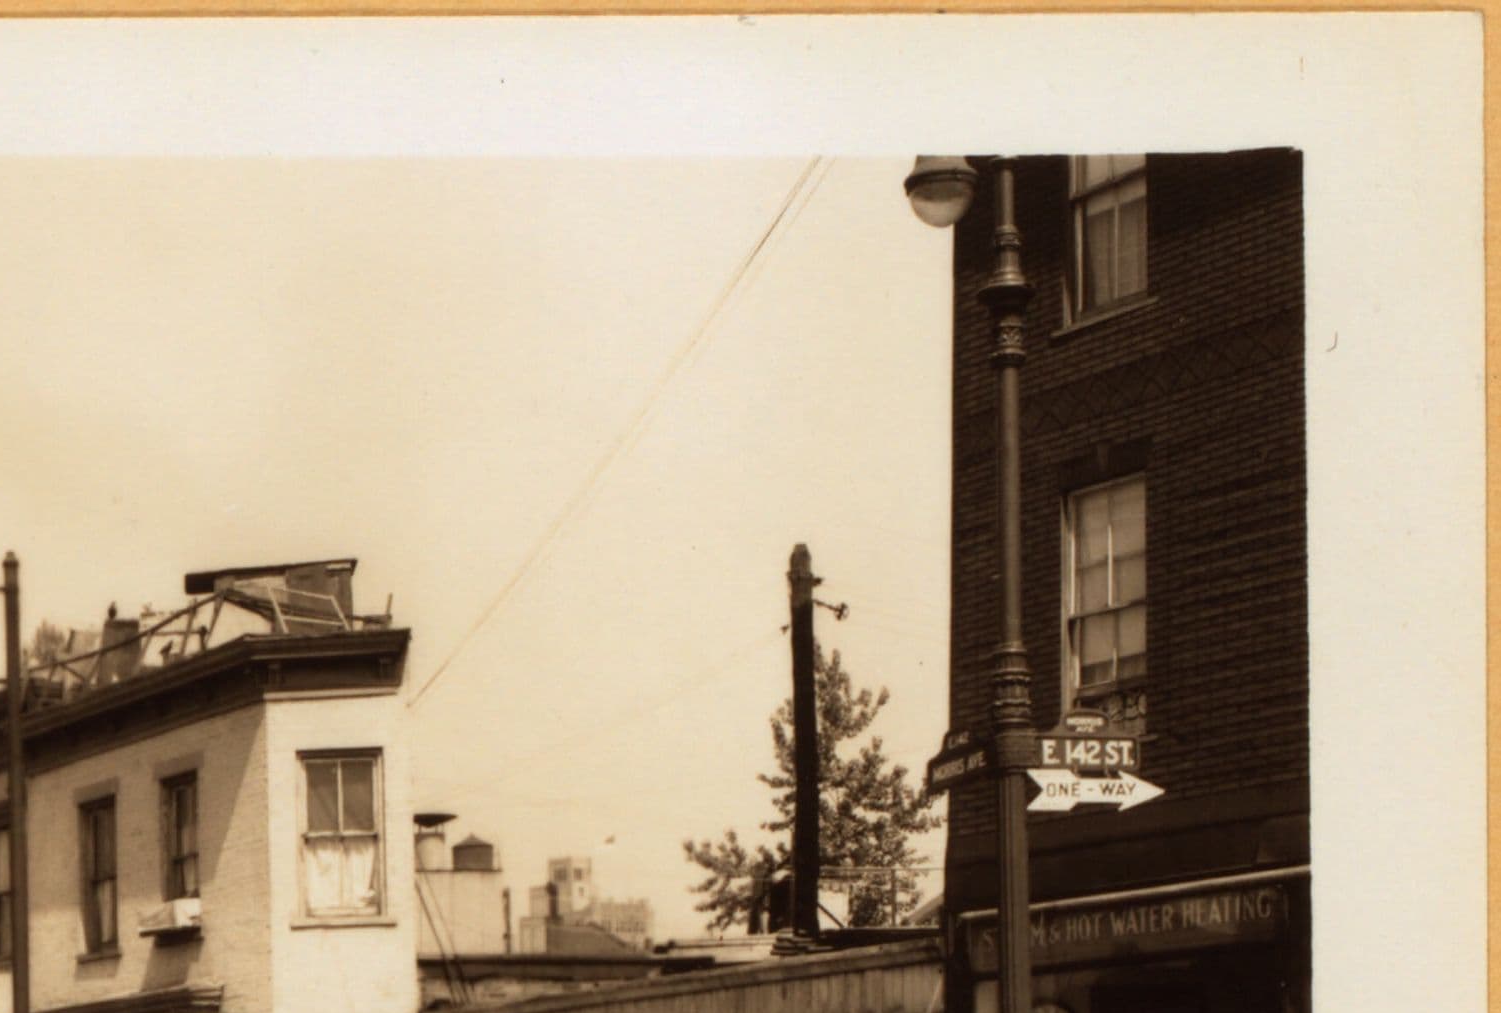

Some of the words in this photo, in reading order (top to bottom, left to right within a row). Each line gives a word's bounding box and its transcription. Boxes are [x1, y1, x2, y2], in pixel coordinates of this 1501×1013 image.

[1065, 739, 1102, 765] 142
[1104, 740, 1135, 766] ST.
[1046, 782, 1081, 798] ONE
[1099, 782, 1137, 797] WAY
[1065, 913, 1102, 943] HOT
[1110, 904, 1174, 936] WATER
[1182, 888, 1273, 928] HEATING
